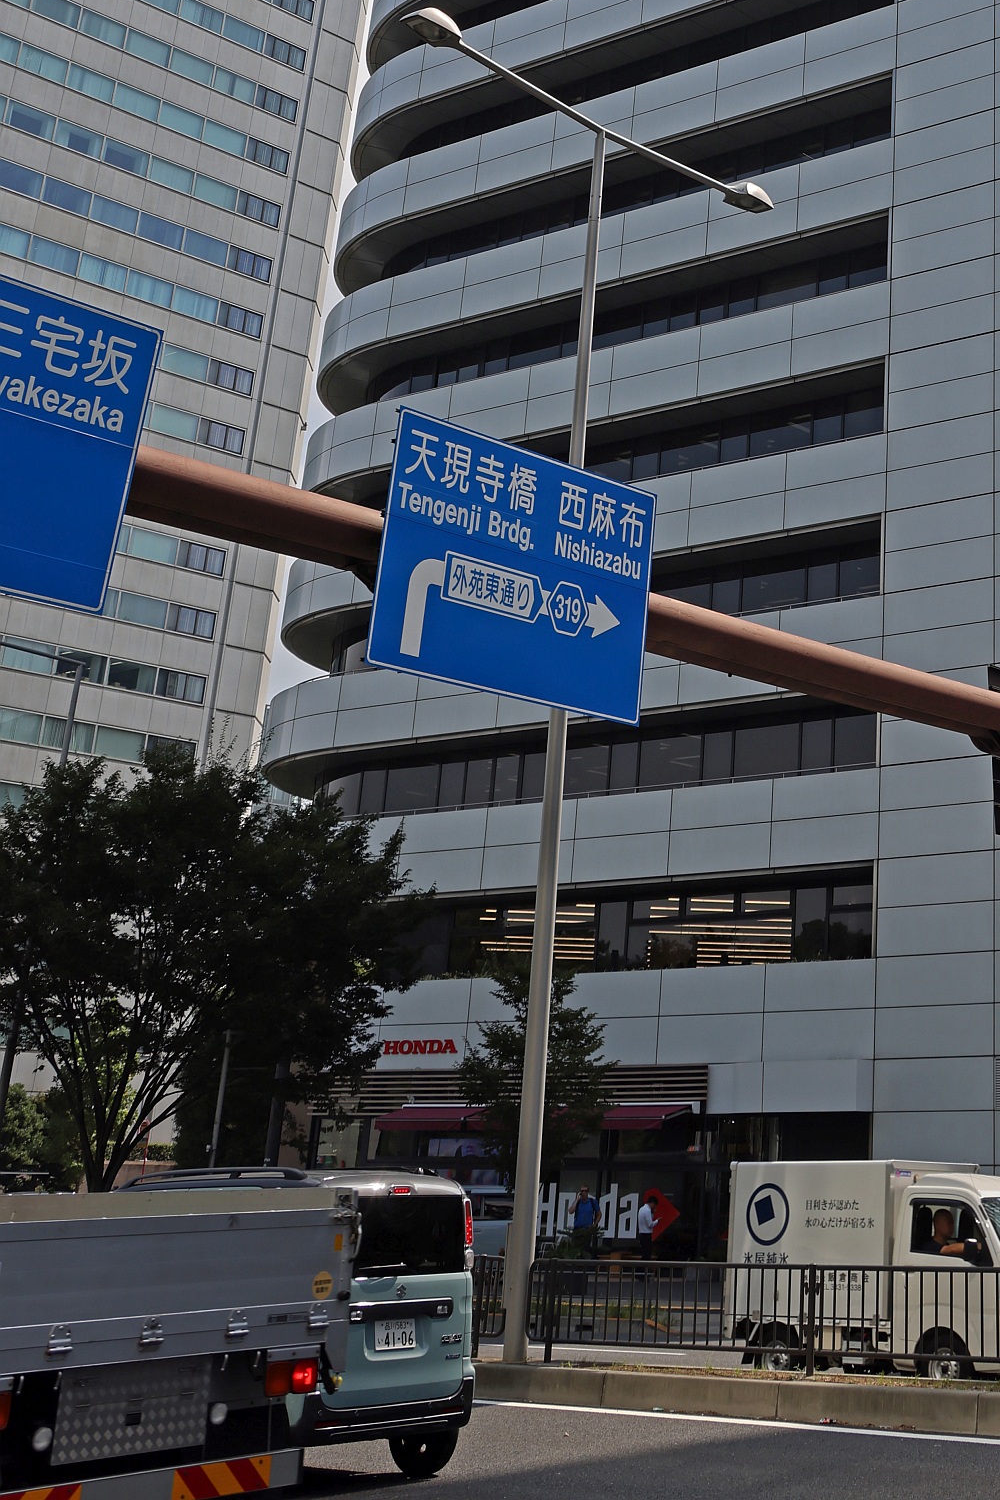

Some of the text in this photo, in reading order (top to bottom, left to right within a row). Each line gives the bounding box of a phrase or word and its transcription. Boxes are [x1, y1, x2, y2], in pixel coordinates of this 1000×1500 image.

[0, 300, 137, 395] 三宅坂
[404, 429, 646, 548] 天現寺橋 西麻布
[398, 481, 641, 580] Tengenji Brdg. Nishiazabu
[451, 563, 531, 611] 外苑東通り
[554, 594, 581, 624] 319
[383, 1039, 458, 1055] HONDA
[536, 1182, 640, 1239] Hoda
